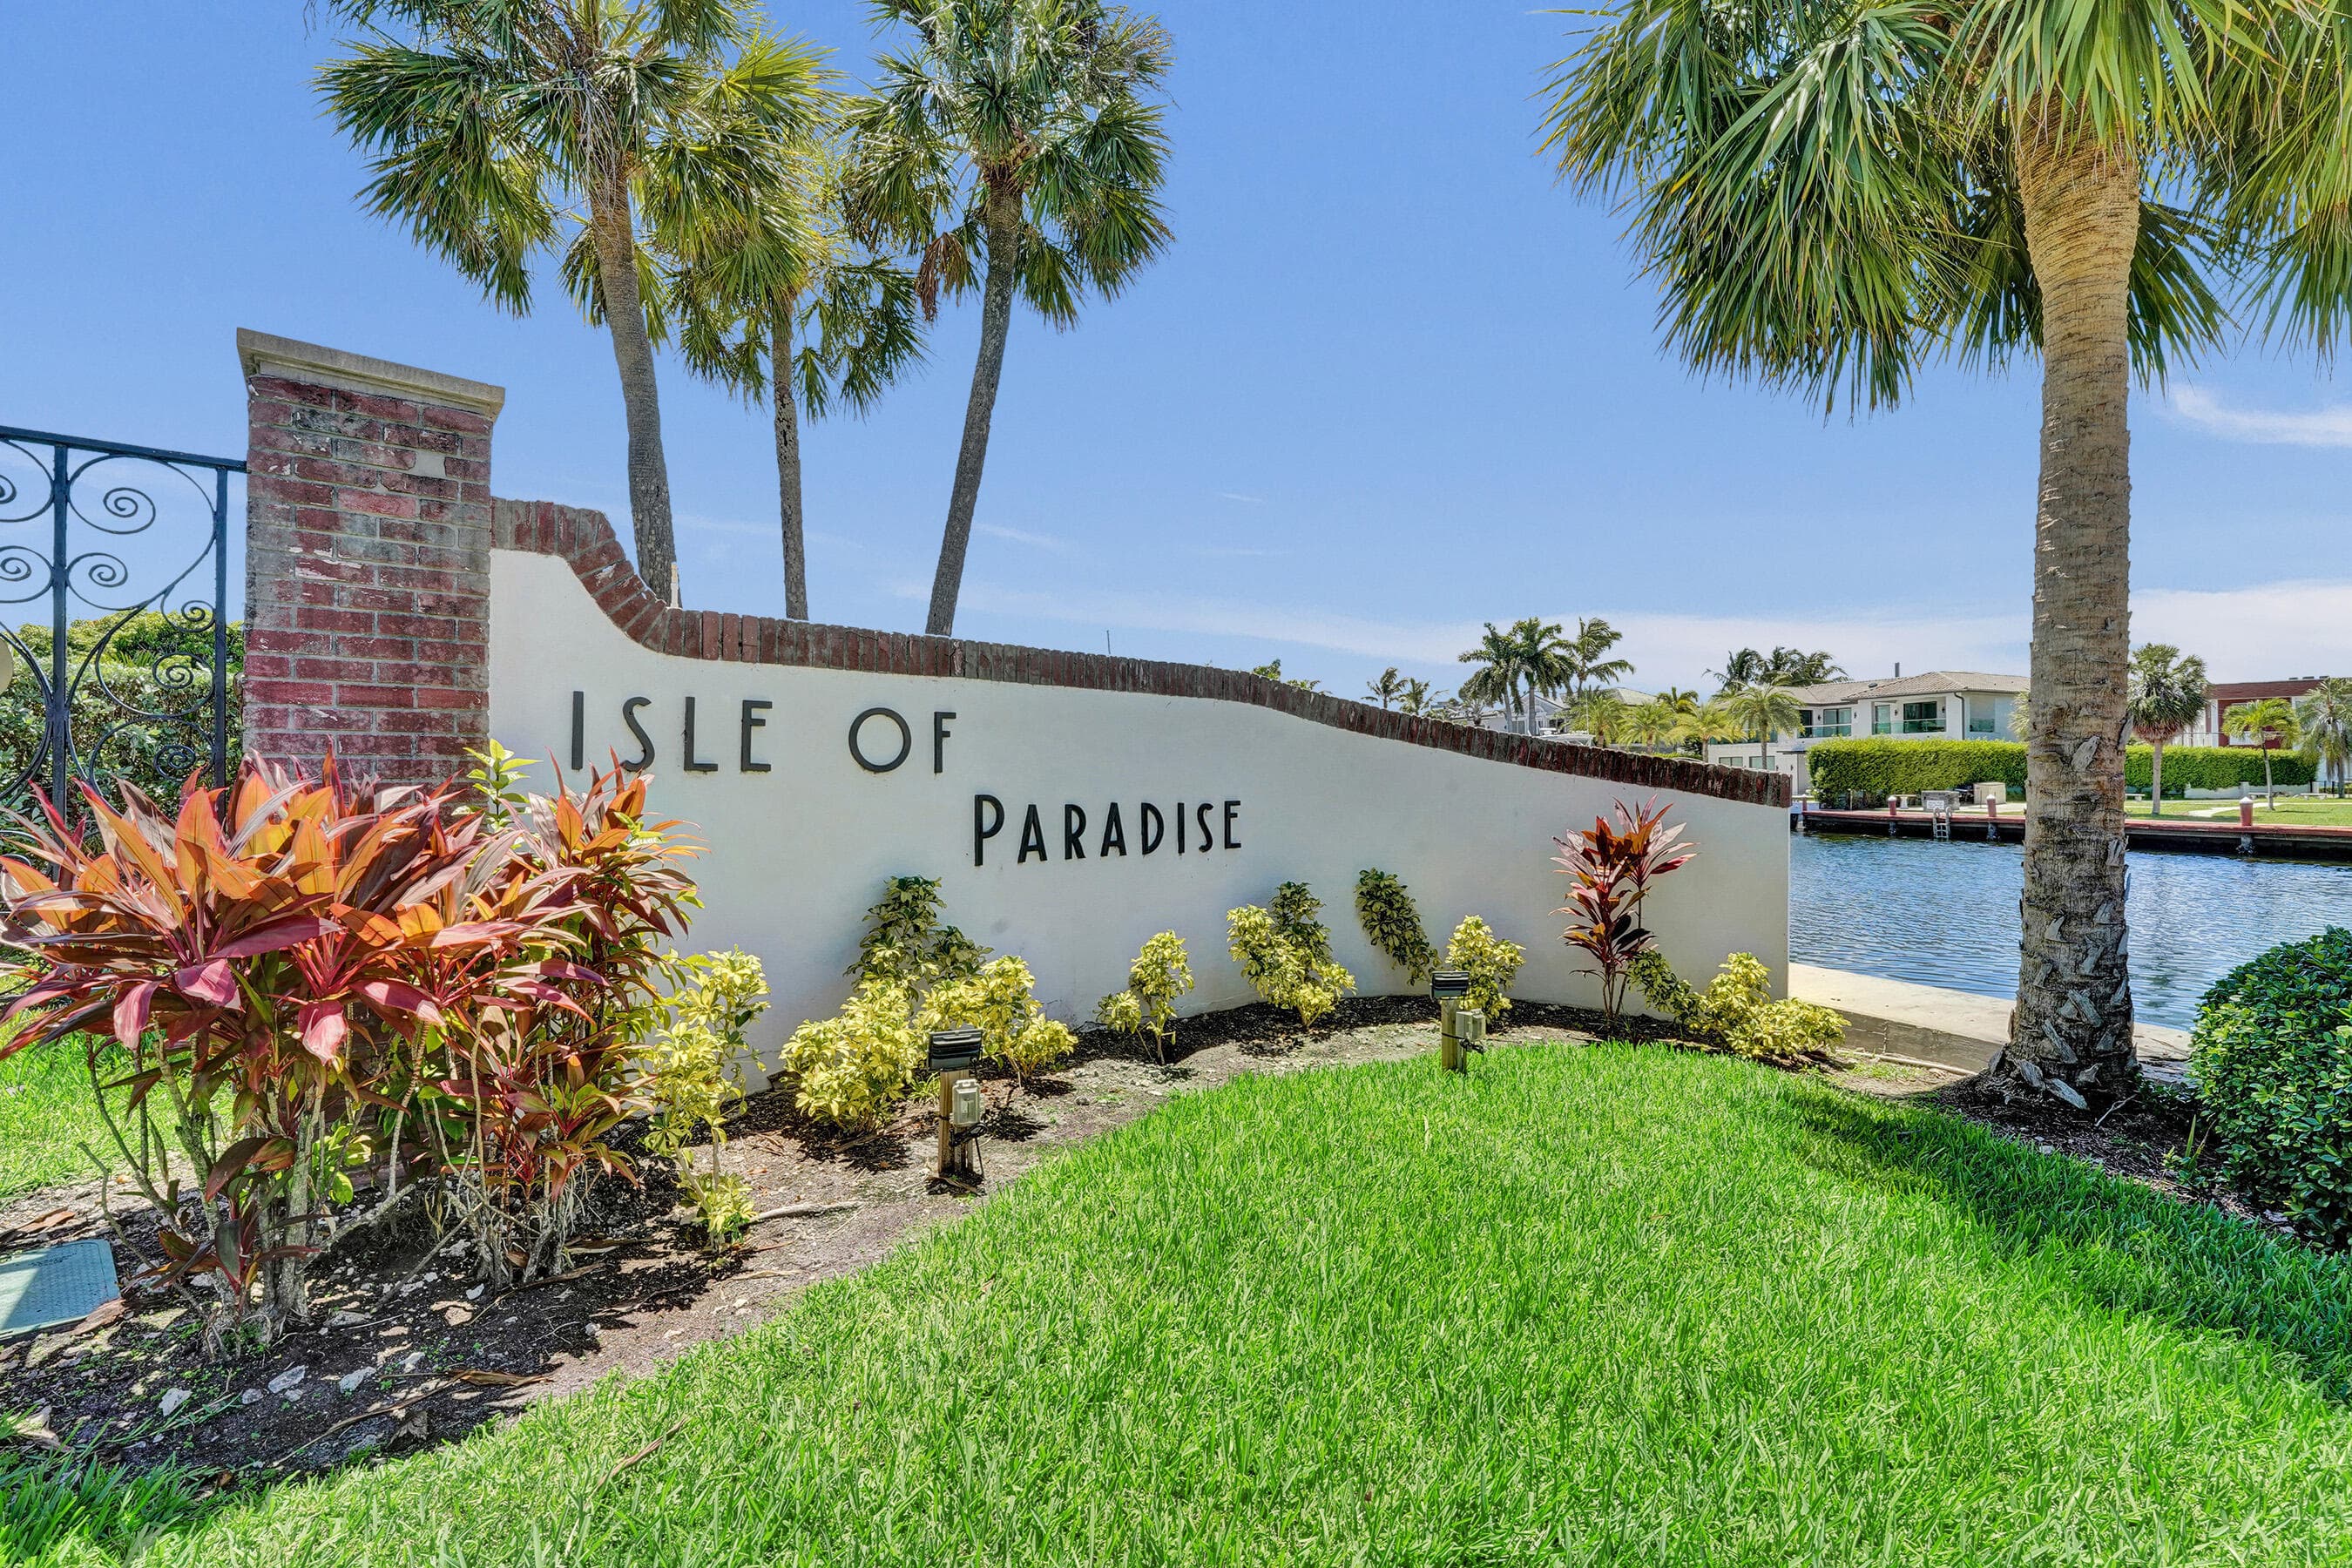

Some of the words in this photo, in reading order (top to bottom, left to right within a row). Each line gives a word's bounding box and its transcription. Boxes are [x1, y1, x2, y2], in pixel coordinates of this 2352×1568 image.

[571, 691, 774, 774] ISLE
[848, 707, 956, 774] OF
[974, 794, 1242, 867] PARADISE
